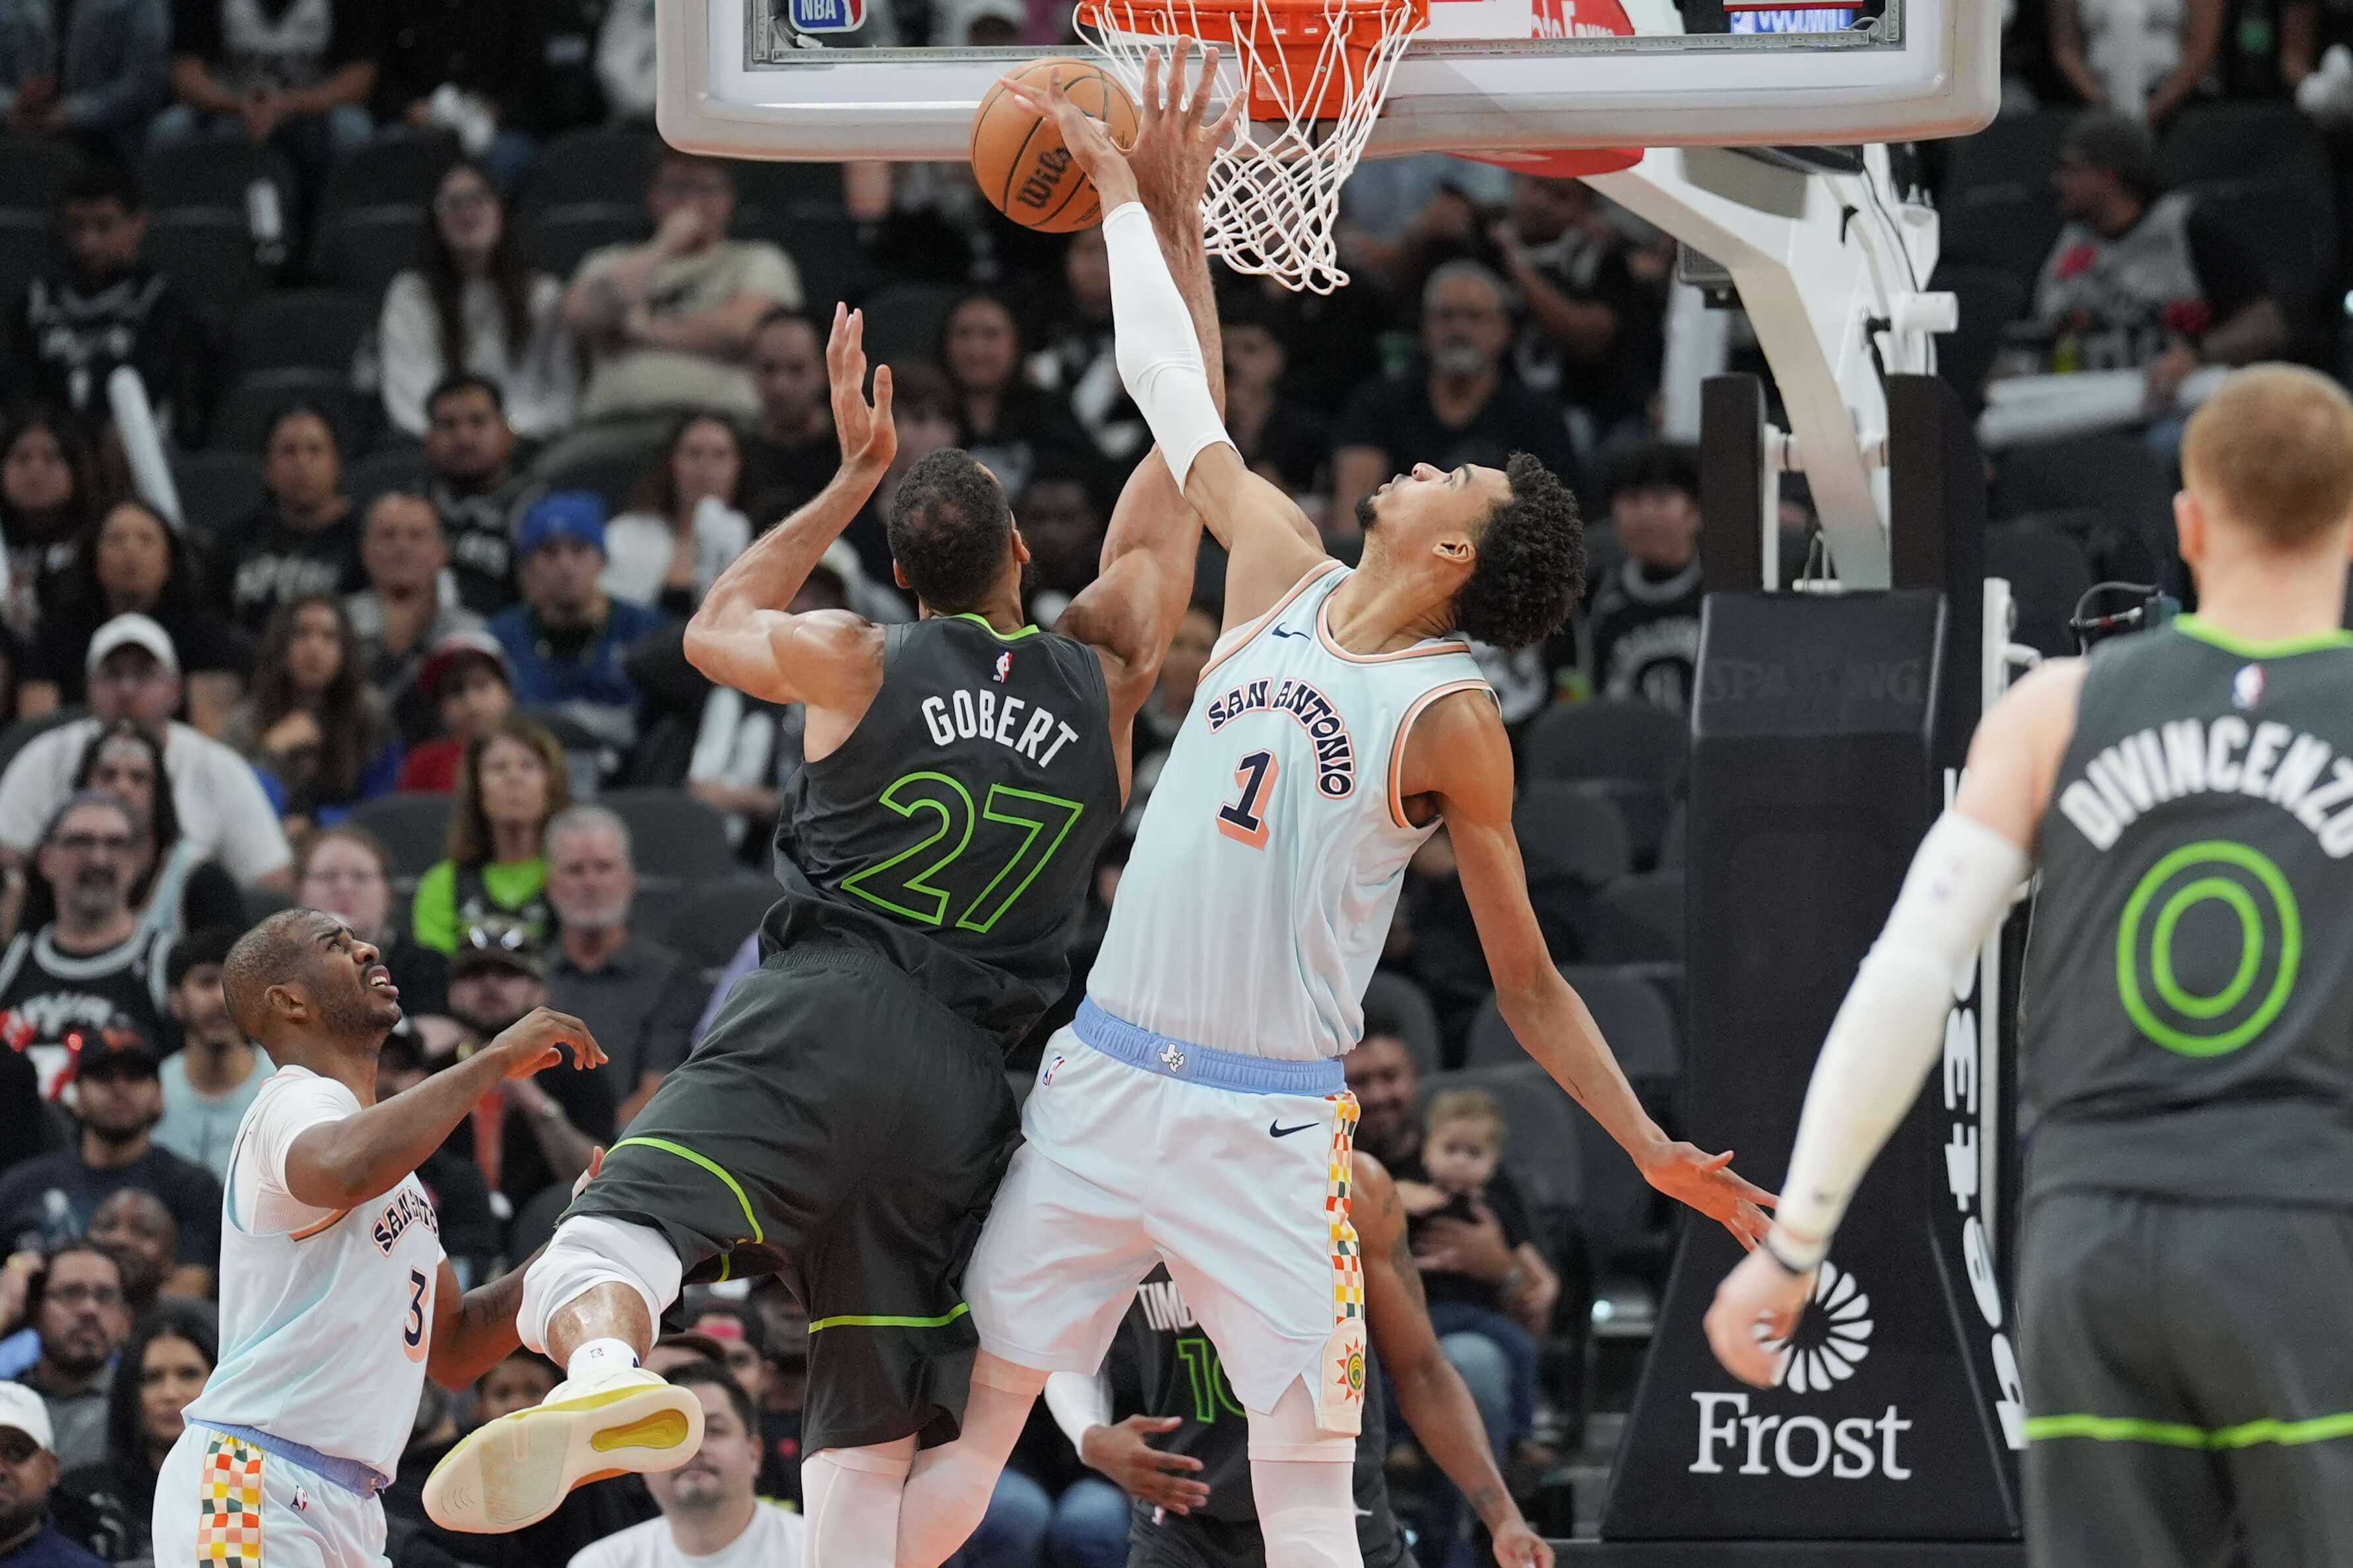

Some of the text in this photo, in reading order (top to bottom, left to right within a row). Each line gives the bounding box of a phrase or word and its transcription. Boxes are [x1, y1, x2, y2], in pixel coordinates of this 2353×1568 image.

[800, 0, 837, 20] NBA
[921, 689, 1080, 768] GOBERT
[1206, 678, 1354, 798] SAN ANTONIO
[1217, 749, 1276, 843] 1
[840, 771, 1084, 933] 27
[2115, 840, 2302, 1057] 0
[373, 1189, 413, 1255] SAN
[403, 1267, 428, 1356] 3
[1688, 1391, 1913, 1481] Frost
